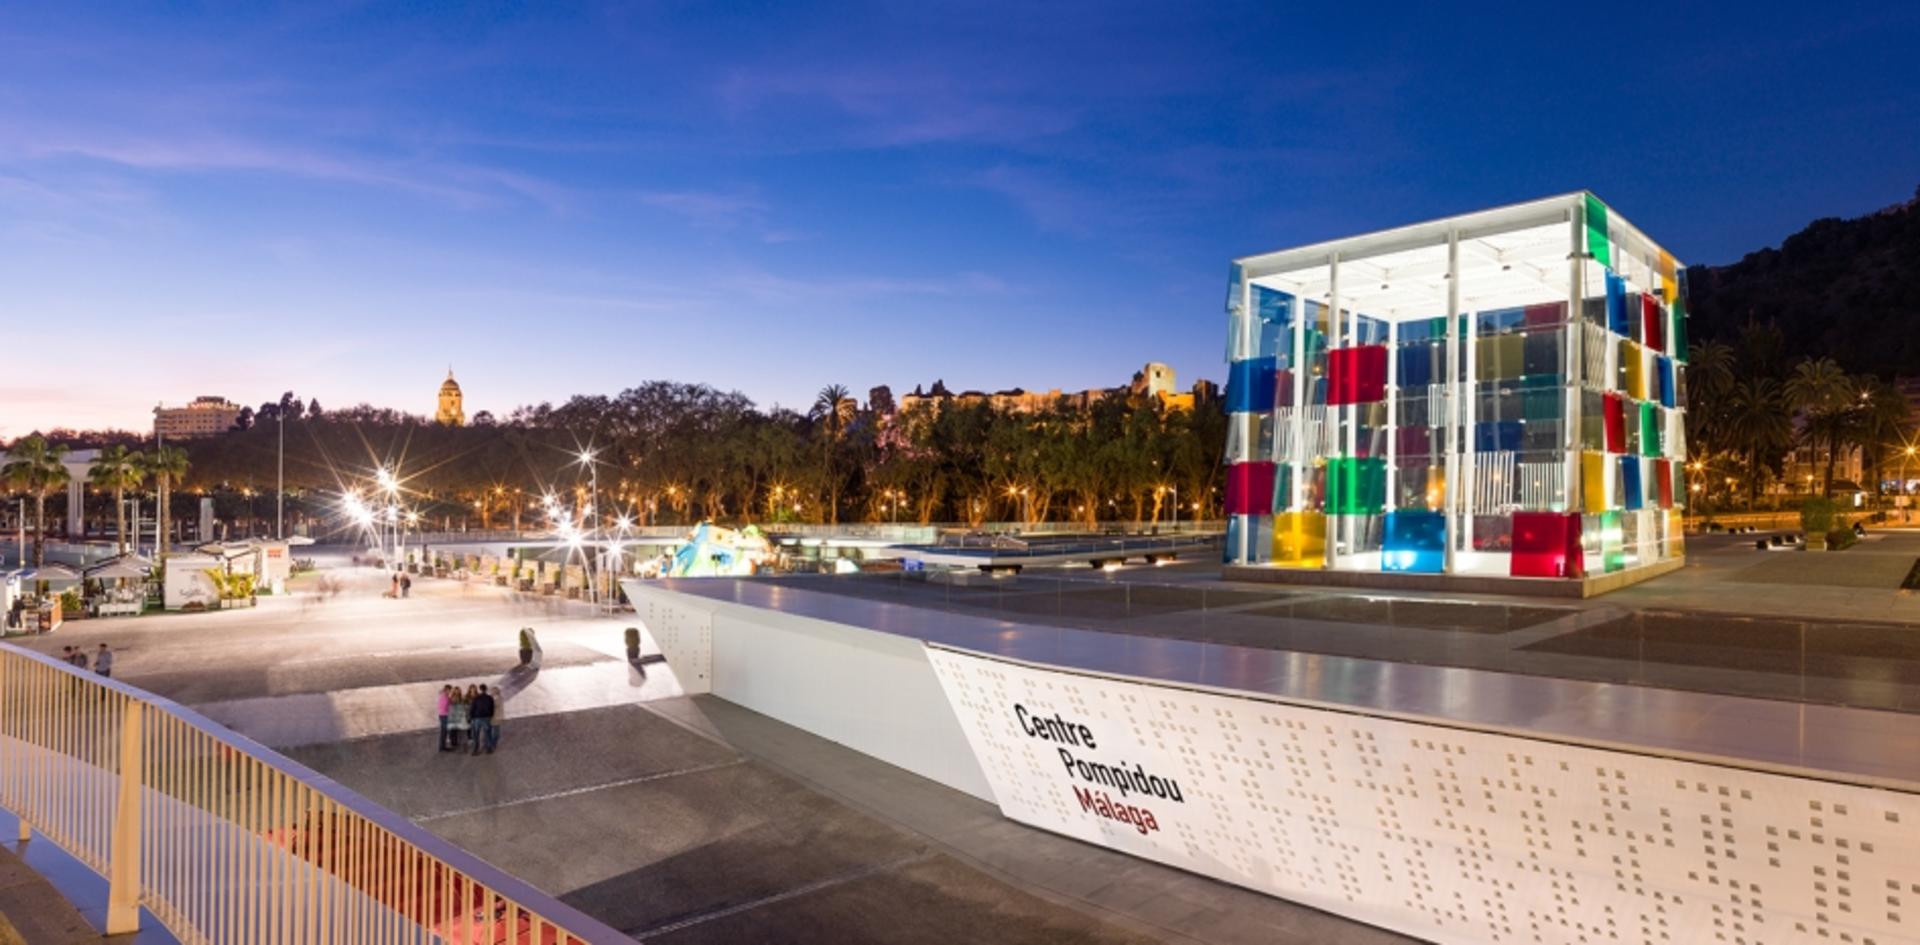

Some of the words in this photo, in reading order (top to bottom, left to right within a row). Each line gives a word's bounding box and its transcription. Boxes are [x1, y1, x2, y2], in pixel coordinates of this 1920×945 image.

[1014, 703, 1097, 749] Centre
[1057, 747, 1185, 804] Pompidou
[1072, 785, 1160, 836] Málaga
